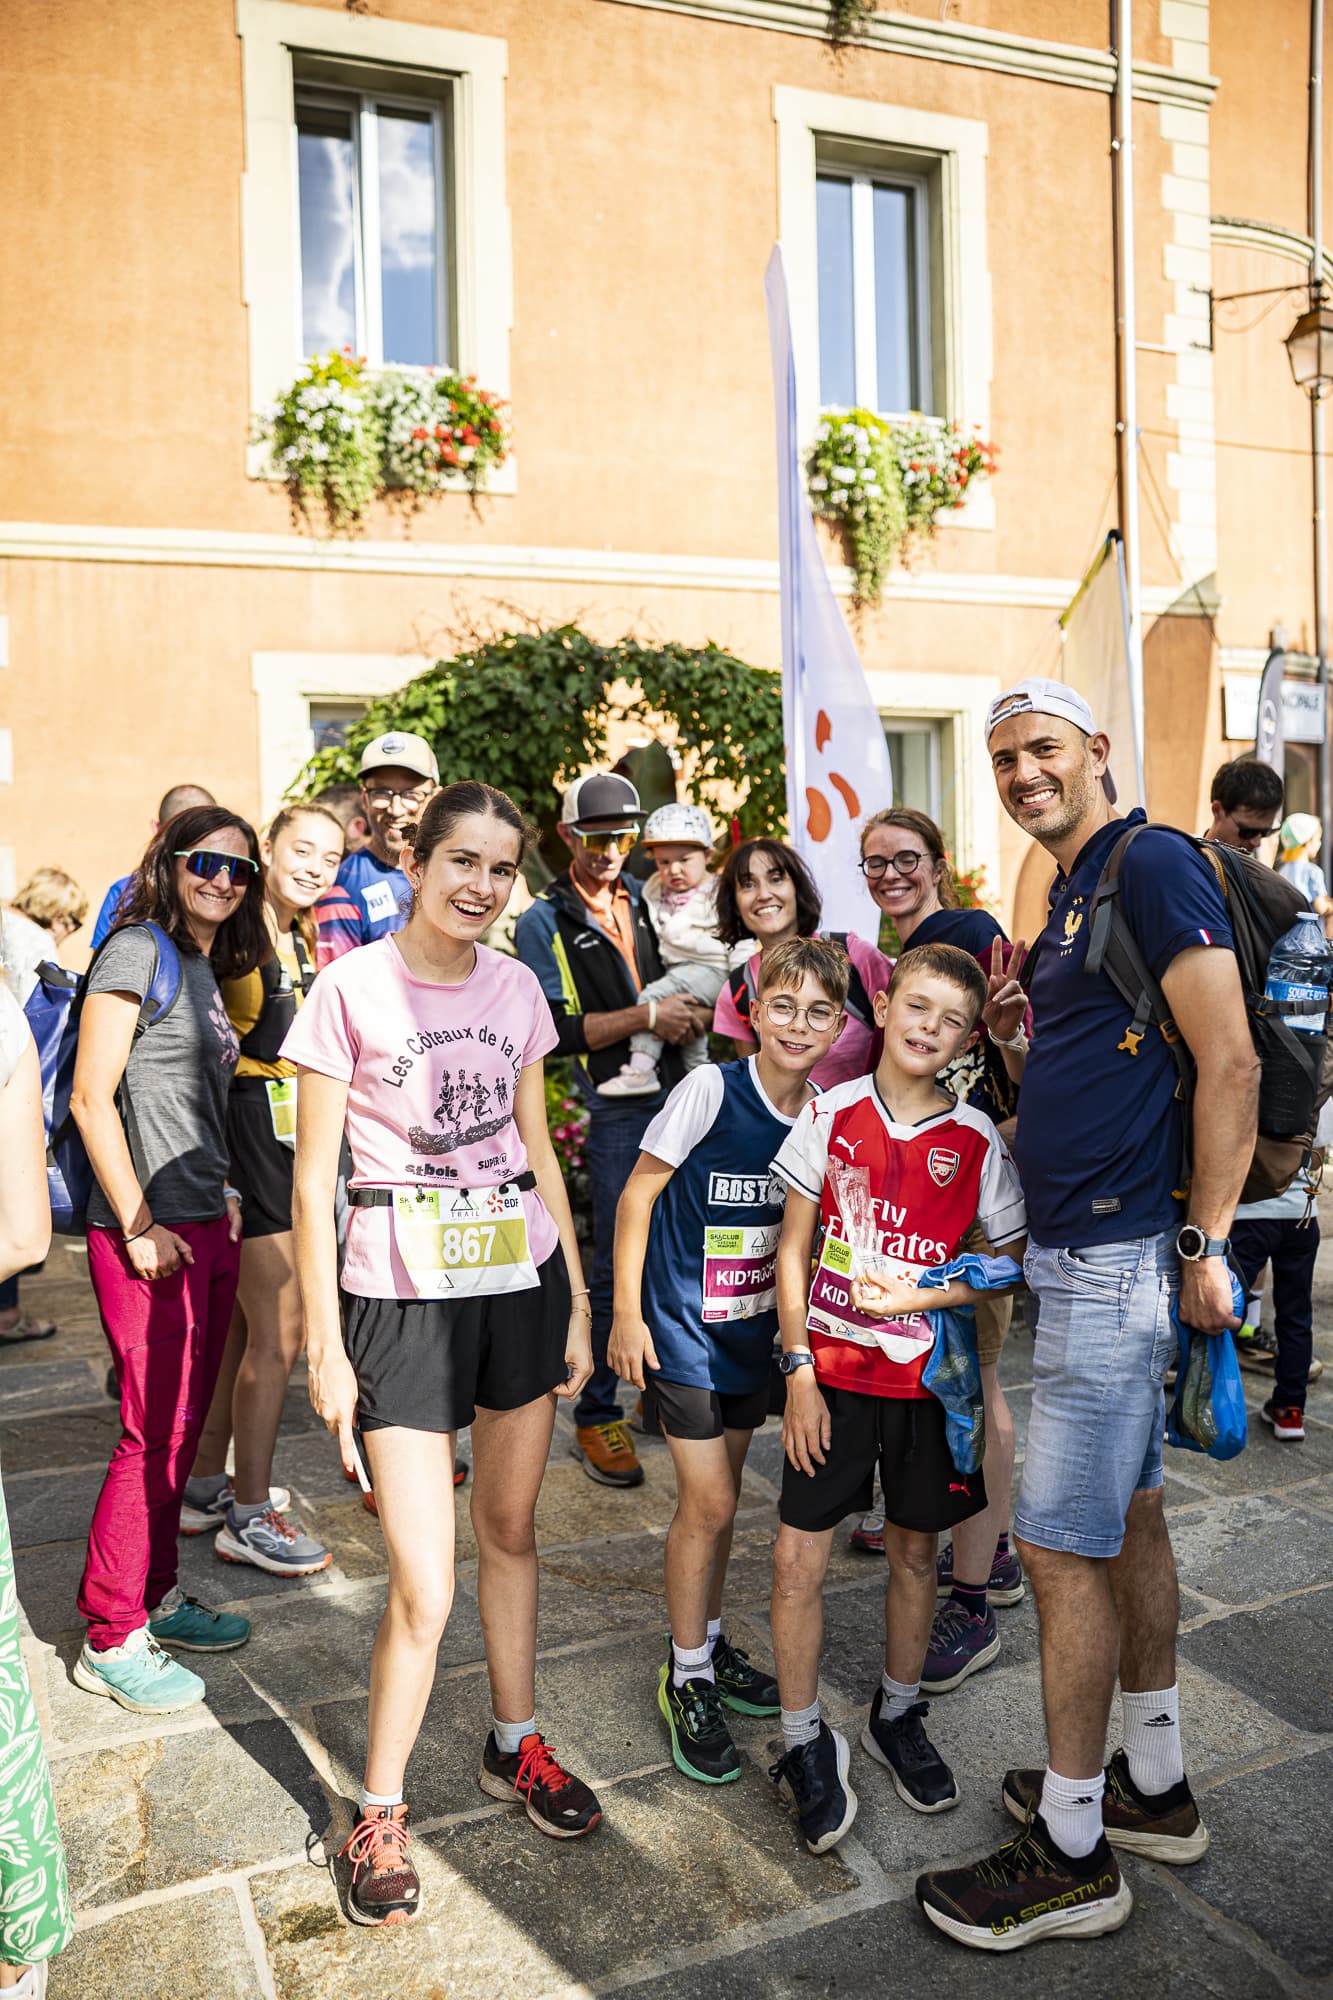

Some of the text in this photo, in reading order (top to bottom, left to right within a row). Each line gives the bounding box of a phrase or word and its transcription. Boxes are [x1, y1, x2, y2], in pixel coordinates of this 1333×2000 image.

[382, 1055, 414, 1088] Les
[406, 1027, 474, 1055] Côteaux
[479, 1025, 497, 1046] de
[500, 1036, 514, 1058] la
[478, 1155, 500, 1170] SUPER
[934, 1153, 956, 1163] Arsenal
[870, 1197, 907, 1228] Fly
[442, 1226, 496, 1265] 867
[827, 1215, 948, 1265] Erates
[716, 1258, 777, 1286] KID'ROCH
[991, 1915, 1020, 1936] LA
[1019, 1874, 1114, 1922] SPORTIVA
